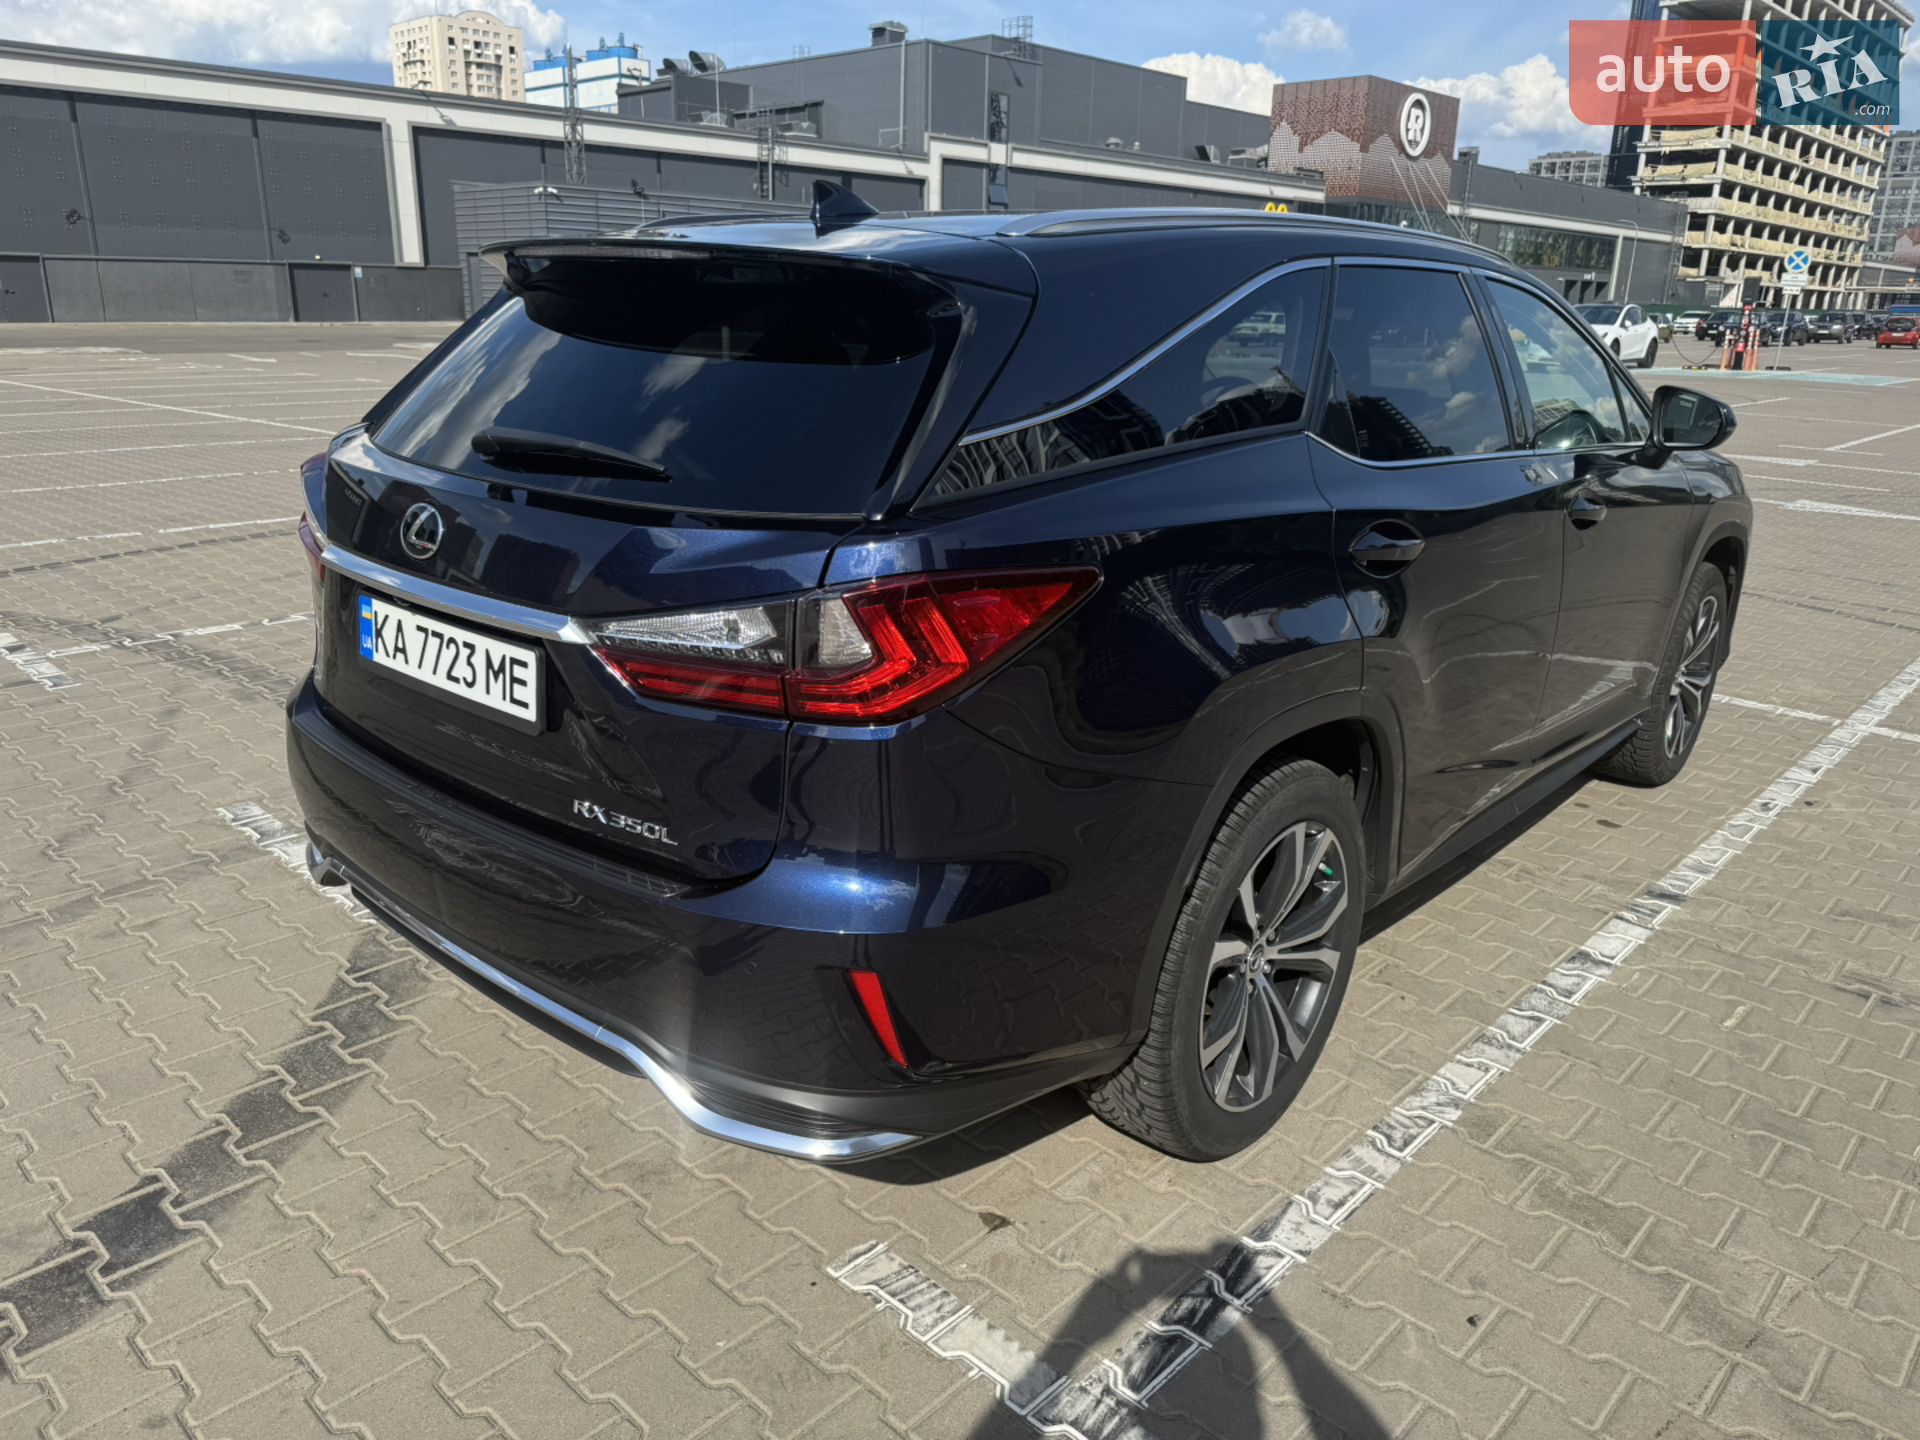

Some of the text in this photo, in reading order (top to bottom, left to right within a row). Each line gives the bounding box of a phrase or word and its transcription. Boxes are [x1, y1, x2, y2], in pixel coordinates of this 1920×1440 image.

[362, 634, 373, 650] UA
[374, 610, 529, 710] KA 7723 ME
[573, 799, 608, 825] RX
